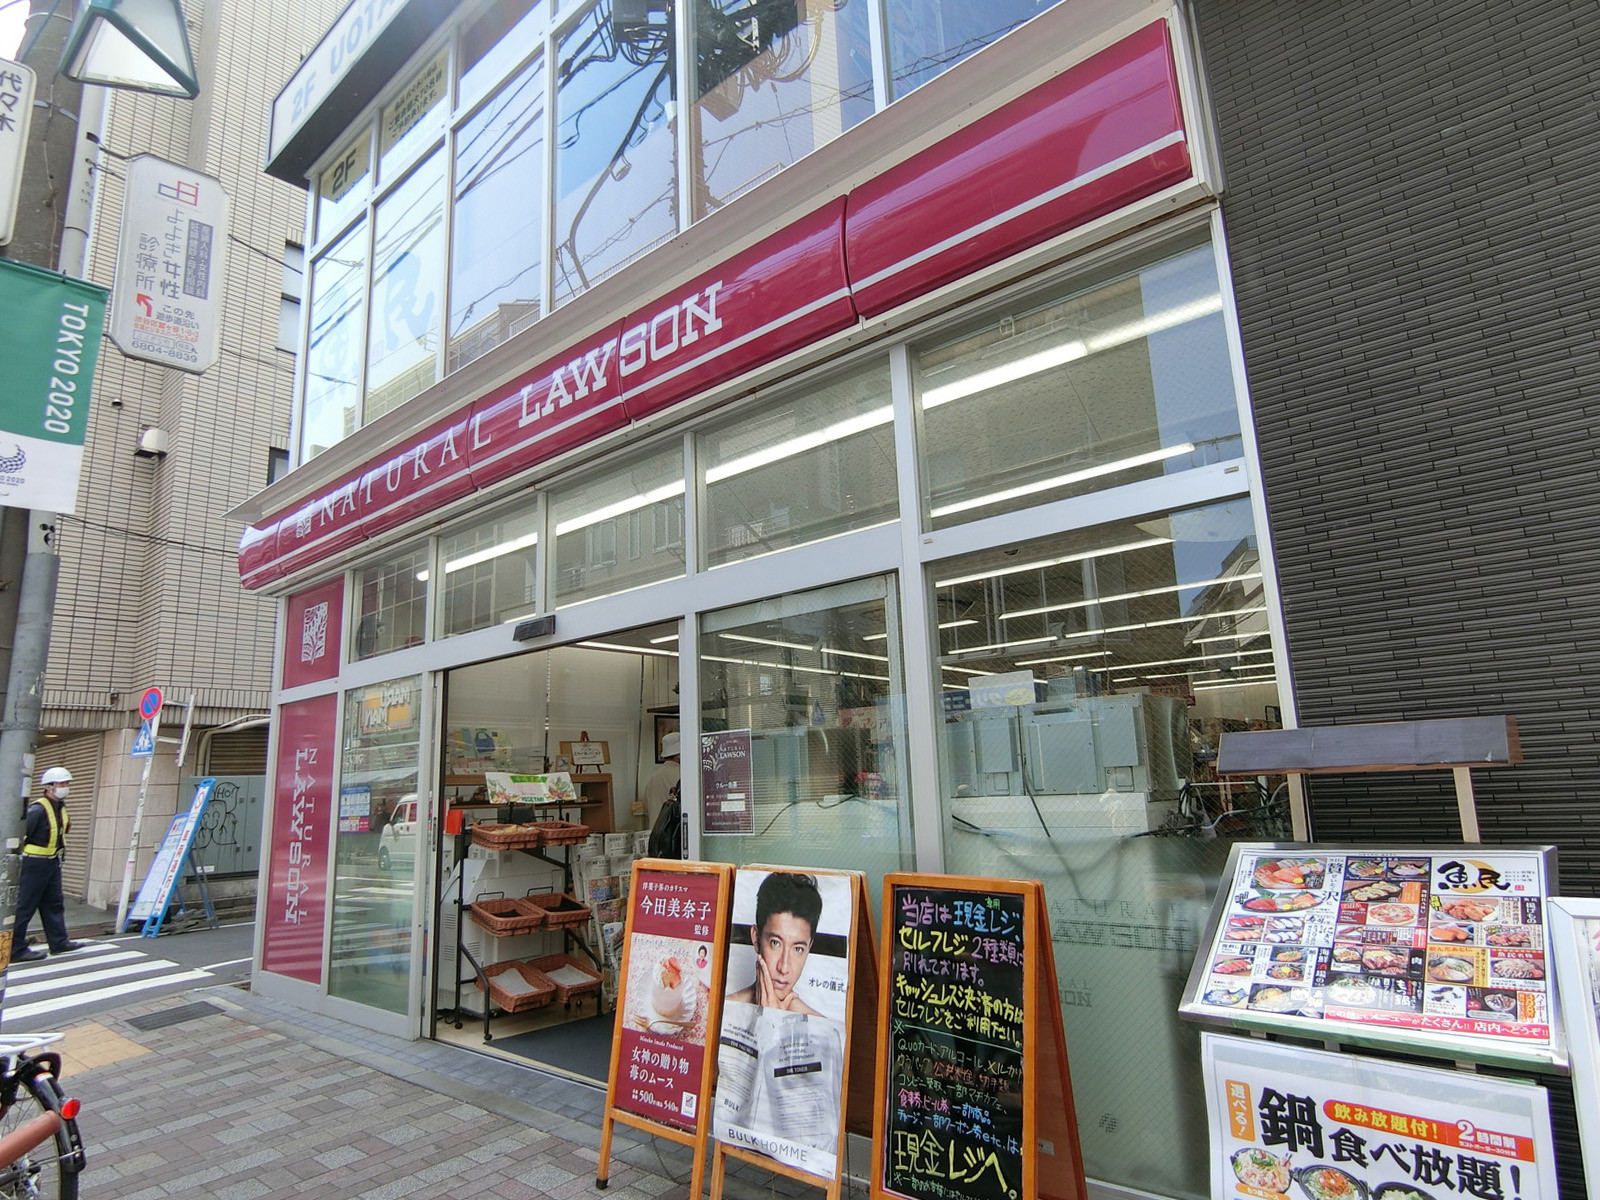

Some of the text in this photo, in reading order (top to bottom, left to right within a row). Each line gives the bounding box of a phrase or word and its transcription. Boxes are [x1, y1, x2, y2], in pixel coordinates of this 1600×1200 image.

[292, 71, 317, 123] 2F
[332, 148, 356, 194] 2F
[136, 232, 160, 292] 診療所
[159, 208, 185, 299] よよぎ女性
[156, 312, 200, 329] 遊歩道沿い
[163, 304, 195, 320] この先
[44, 301, 89, 435] TOKYO 2020
[131, 340, 198, 363] 6804-8839
[319, 280, 723, 527] NATURAL LAWSON
[719, 751, 746, 759] LAWSON
[284, 749, 309, 924] LAWSON
[299, 748, 319, 918] NATURAL
[642, 882, 688, 892] 洋菓子界のカリスマ
[1437, 861, 1510, 891] 魚民
[640, 895, 712, 921] 今田美奈子
[694, 924, 710, 936] 監修
[808, 978, 847, 993] オレの儀式。
[903, 951, 985, 987] 別れております。
[896, 996, 1022, 1048] セルフレジをご利用下さい。
[629, 1064, 674, 1089] 苺のムース
[631, 1046, 690, 1075] 女神の贈り物
[723, 1098, 740, 1112] BULK
[1230, 1083, 1248, 1137] 選べる!
[1334, 1103, 1438, 1139] 飲み放題付!
[728, 1128, 809, 1163] BULK HOMME
[1457, 1120, 1517, 1149] 2時間制
[893, 1129, 1017, 1200] 現金レジへ。
